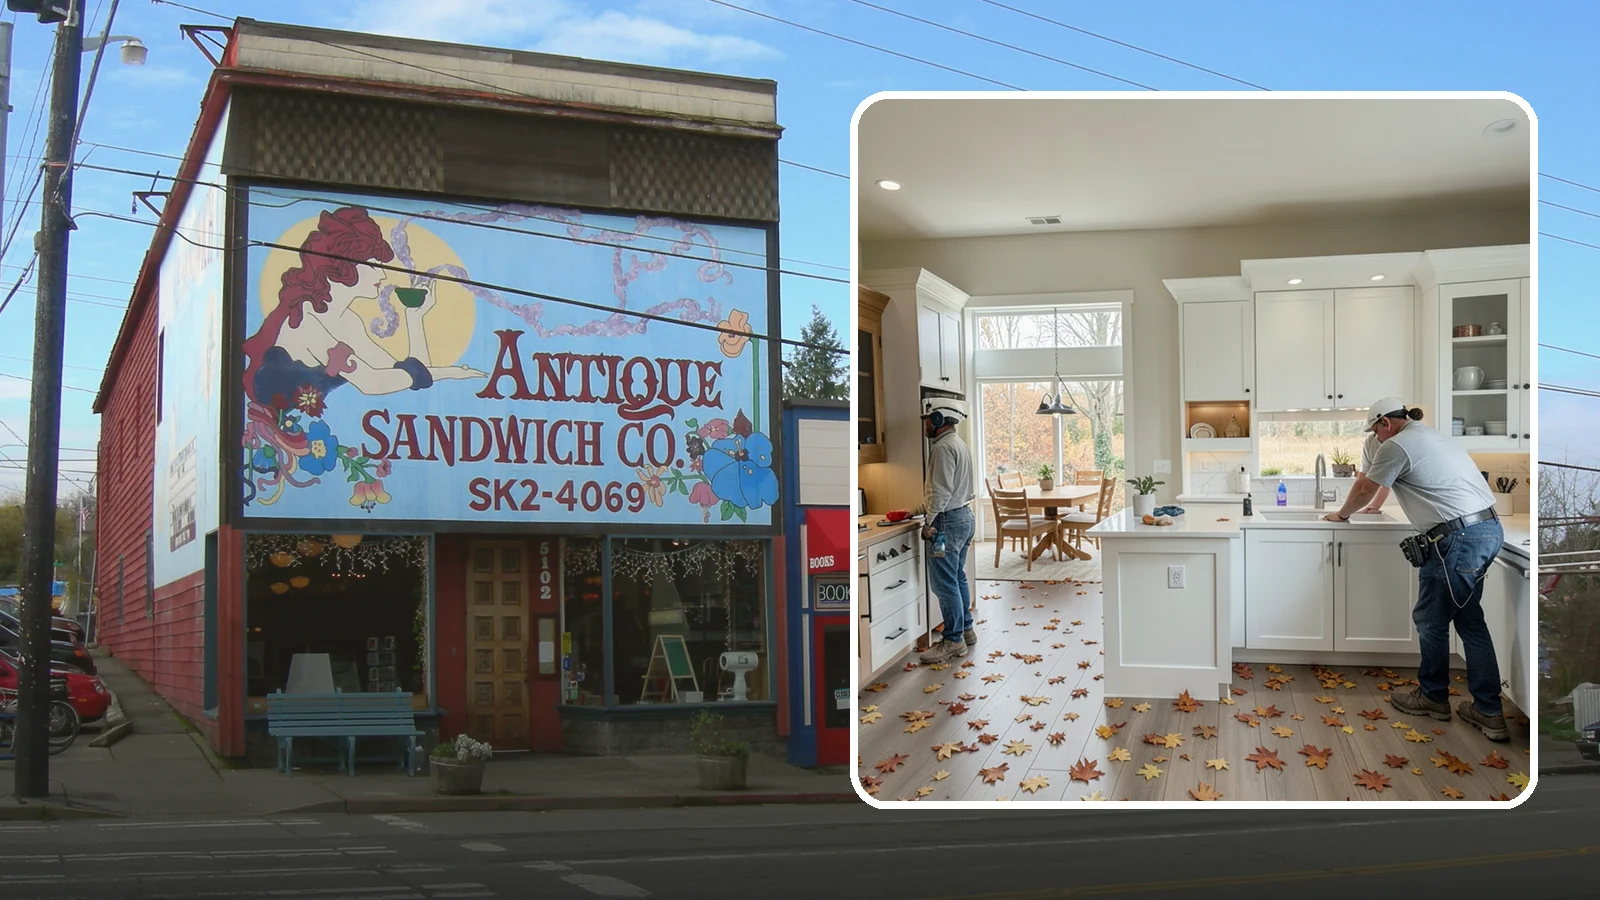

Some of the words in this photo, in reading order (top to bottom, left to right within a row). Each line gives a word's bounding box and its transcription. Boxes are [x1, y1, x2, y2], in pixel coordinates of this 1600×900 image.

[475, 328, 724, 421] ANTIQUE
[362, 408, 604, 467] SANDWICH
[617, 422, 685, 469] CO.
[468, 477, 646, 514] SK2-4069
[540, 541, 551, 600] 5102
[809, 555, 835, 569] BOOKS
